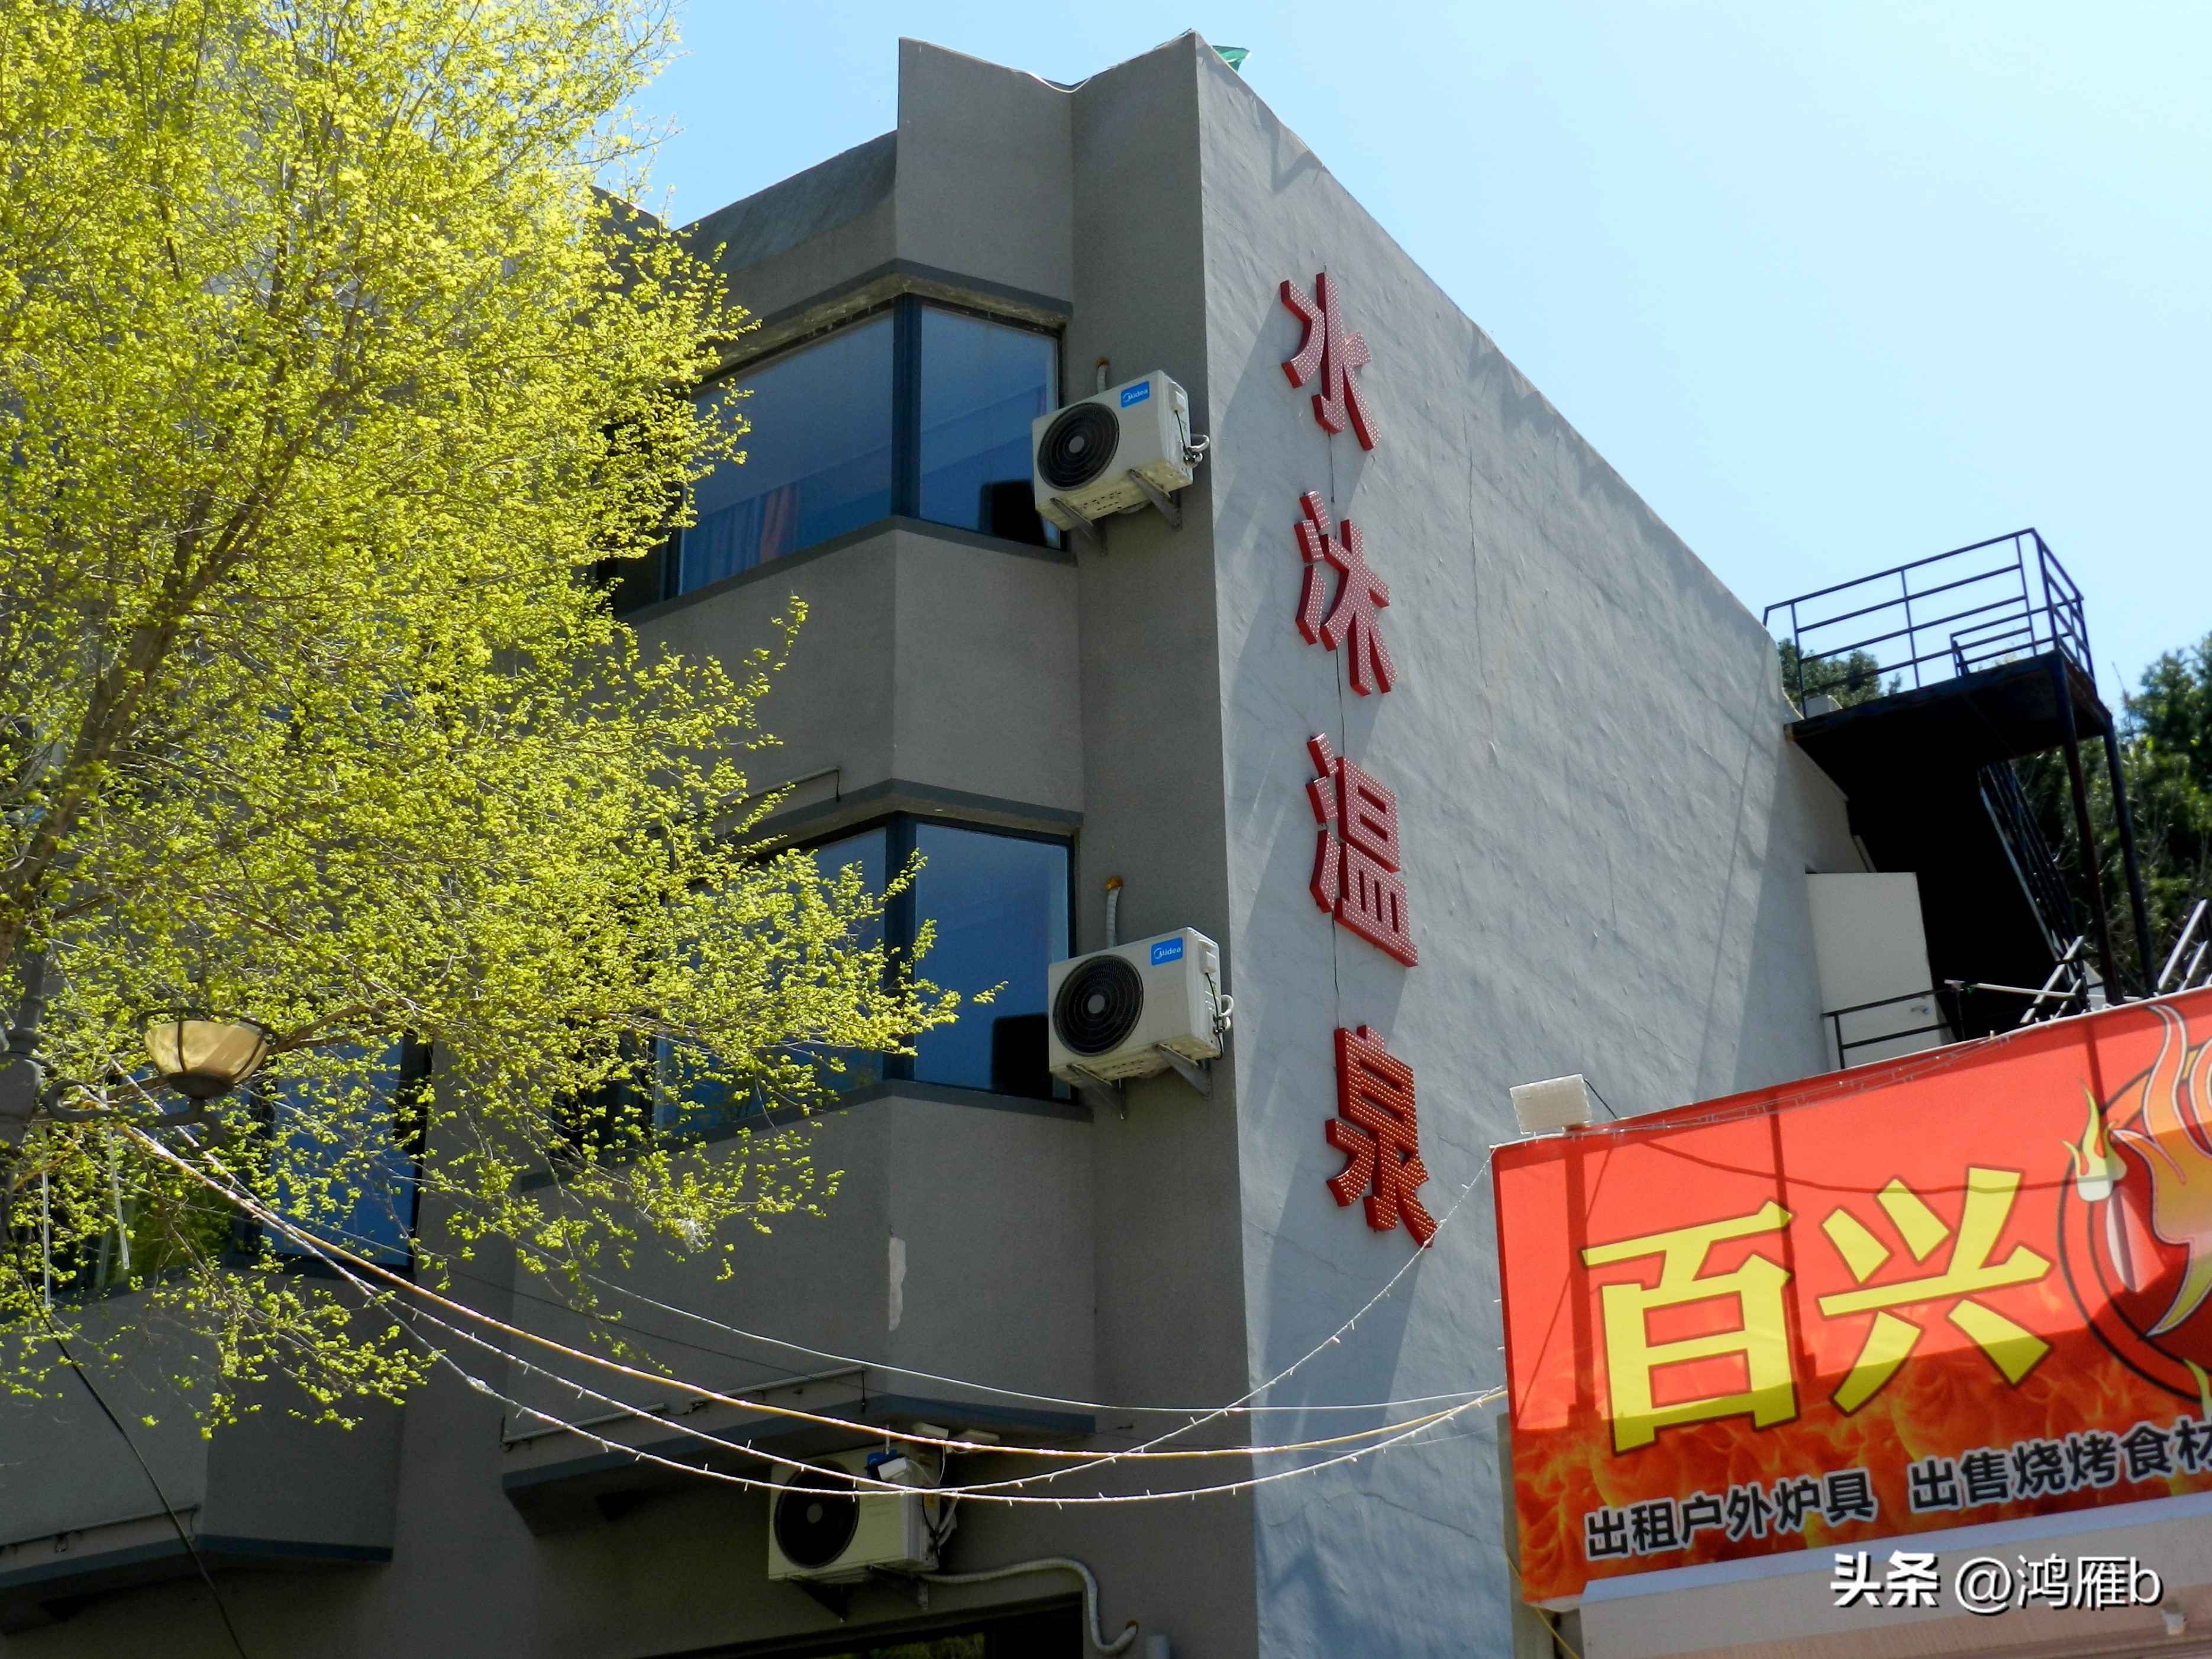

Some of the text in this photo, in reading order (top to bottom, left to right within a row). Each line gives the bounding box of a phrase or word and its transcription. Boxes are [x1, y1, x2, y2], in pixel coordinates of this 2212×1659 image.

[1122, 389, 1148, 403] Midea
[1280, 272, 1439, 1248] 水沐温泉
[1154, 947, 1181, 959] Midea
[1581, 1167, 2052, 1456] 百兴
[1587, 1419, 2212, 1557] 出租户外炉具 出售烧烤食材
